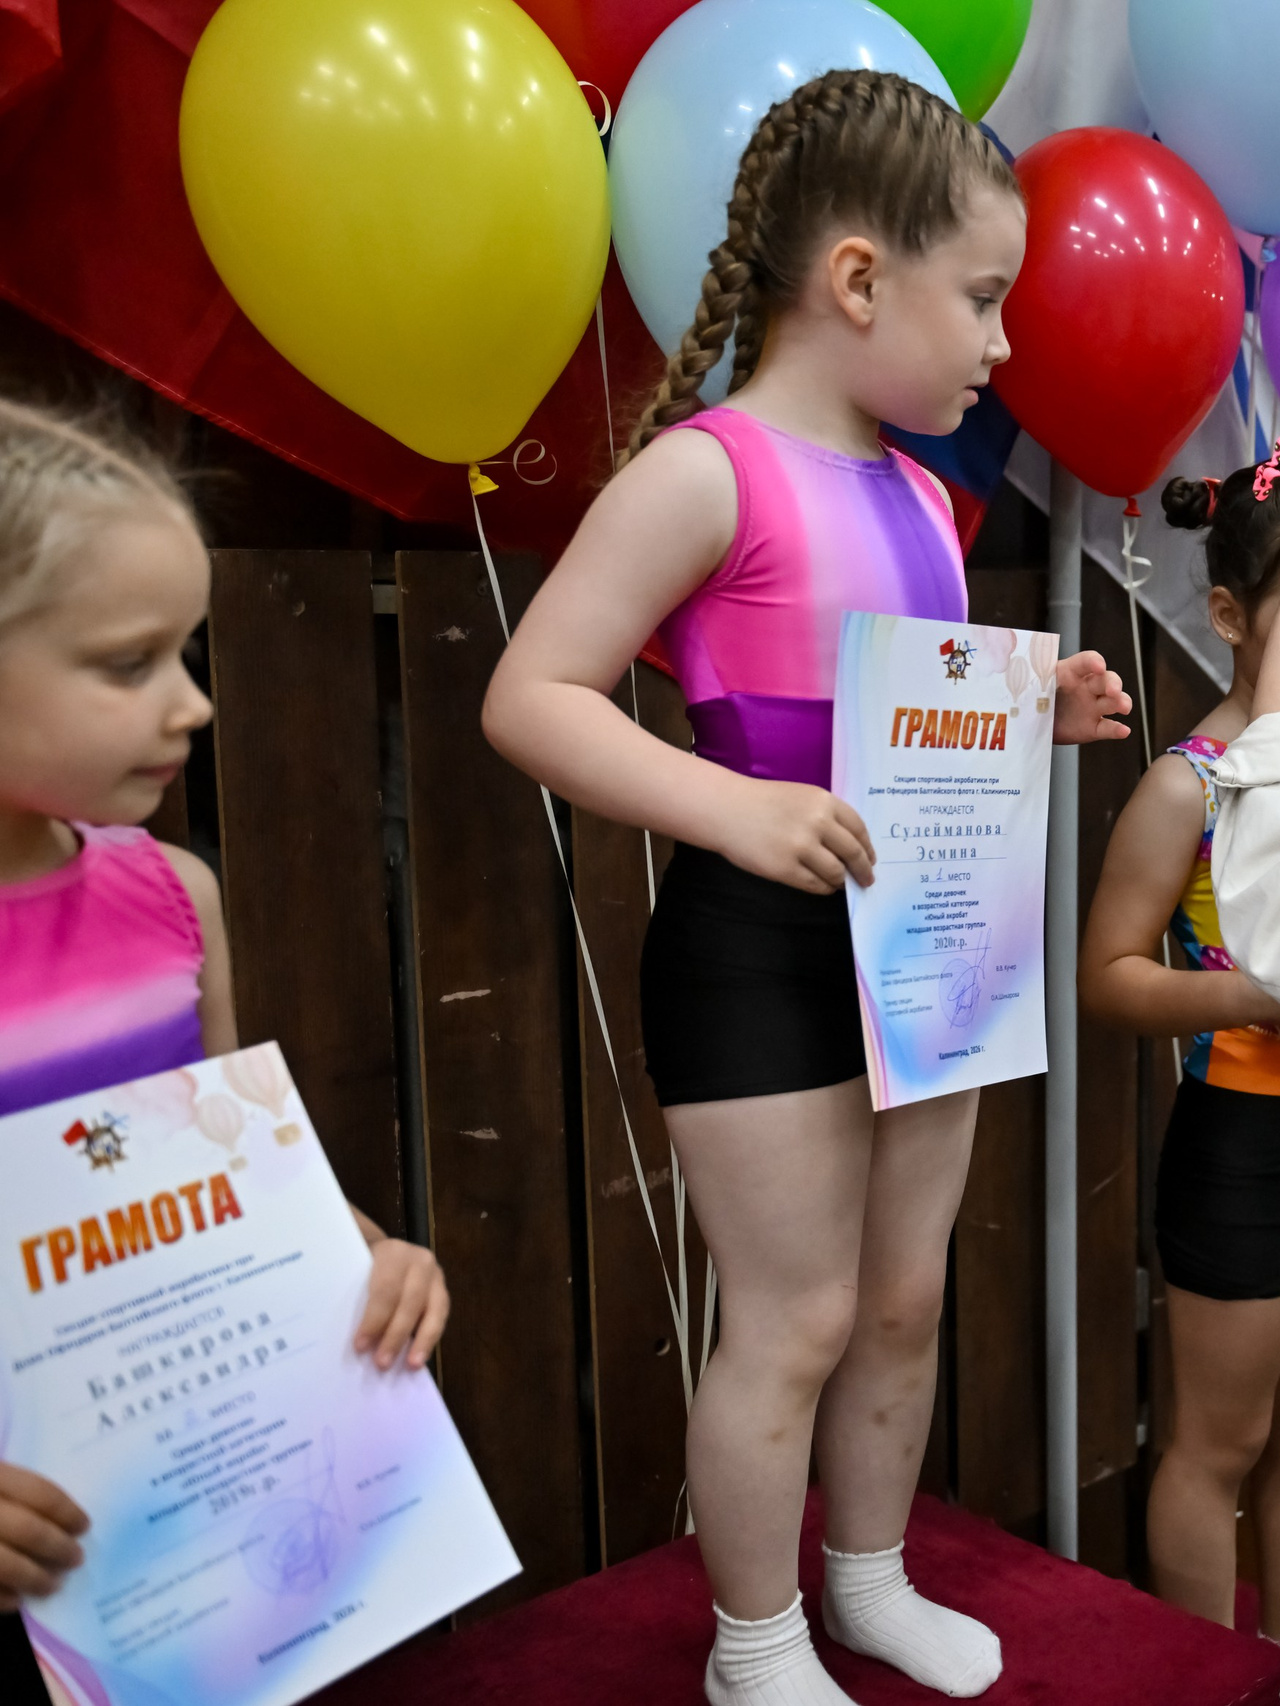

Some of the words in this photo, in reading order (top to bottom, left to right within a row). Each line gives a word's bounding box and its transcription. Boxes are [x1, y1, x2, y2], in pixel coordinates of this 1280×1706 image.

[890, 706, 1008, 751] ГРАМОТА
[894, 775, 916, 783] Секция
[917, 776, 952, 784] спортивной
[954, 777, 987, 785] акробатики
[887, 787, 918, 795] Офицеров
[919, 787, 956, 795] Балтийского
[958, 788, 975, 796] флота
[981, 788, 1021, 797] Калининграда
[919, 805, 974, 815] НАГРАЖДАЕТСЯ
[890, 822, 1001, 842] Сулейманова
[916, 846, 977, 861] Эсмина
[920, 874, 929, 883] за
[947, 872, 971, 881] место
[925, 891, 942, 899] Среди
[943, 889, 966, 898] девочек
[917, 901, 949, 911] возрастной
[950, 900, 979, 909] категории
[946, 911, 968, 920] акробат
[933, 923, 964, 932] возрастная
[934, 936, 967, 949] 2020г.р.
[20, 1171, 244, 1295] ГРАМОТА
[87, 1311, 272, 1400] Башкирова
[98, 1337, 288, 1430] Александра
